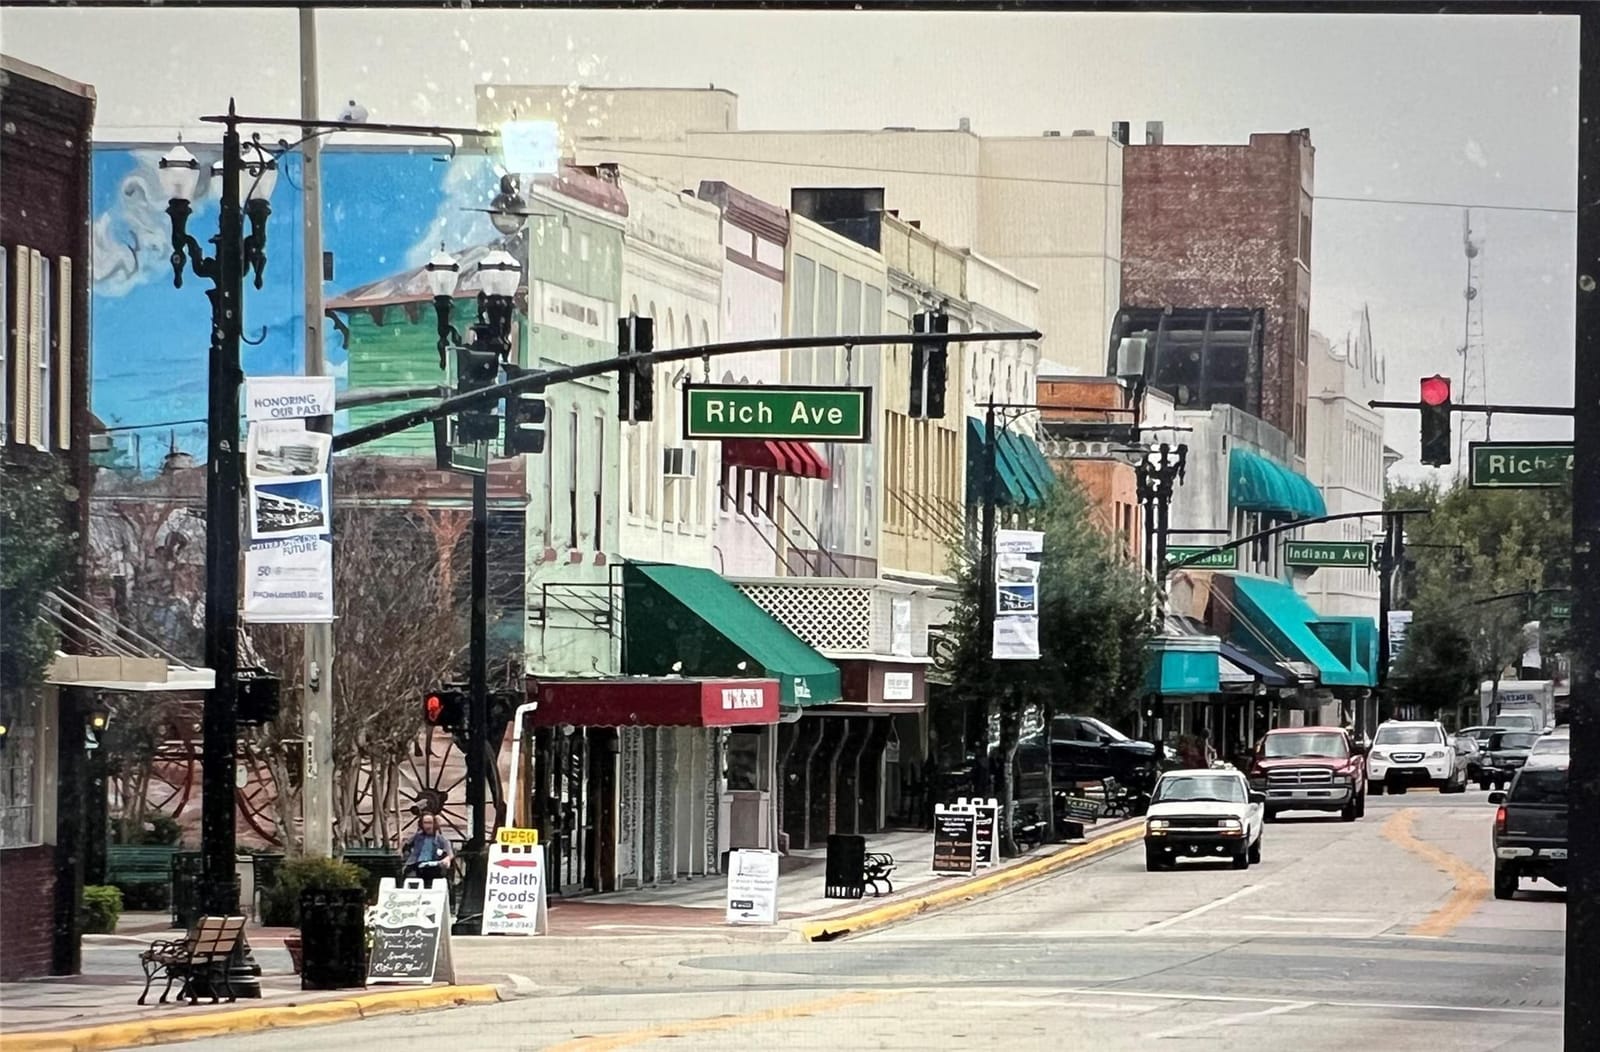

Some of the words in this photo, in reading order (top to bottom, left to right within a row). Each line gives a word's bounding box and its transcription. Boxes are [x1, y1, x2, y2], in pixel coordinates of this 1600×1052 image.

[254, 394, 316, 408] HONORING
[270, 406, 294, 418] OUR
[706, 400, 773, 423] Rich
[790, 401, 843, 425] Ave
[282, 541, 319, 556] FUTURE
[1289, 546, 1336, 560] Indiana
[1342, 548, 1365, 560] Ave
[257, 565, 272, 577] 50
[488, 871, 538, 886] Health
[487, 888, 537, 903] Foods
